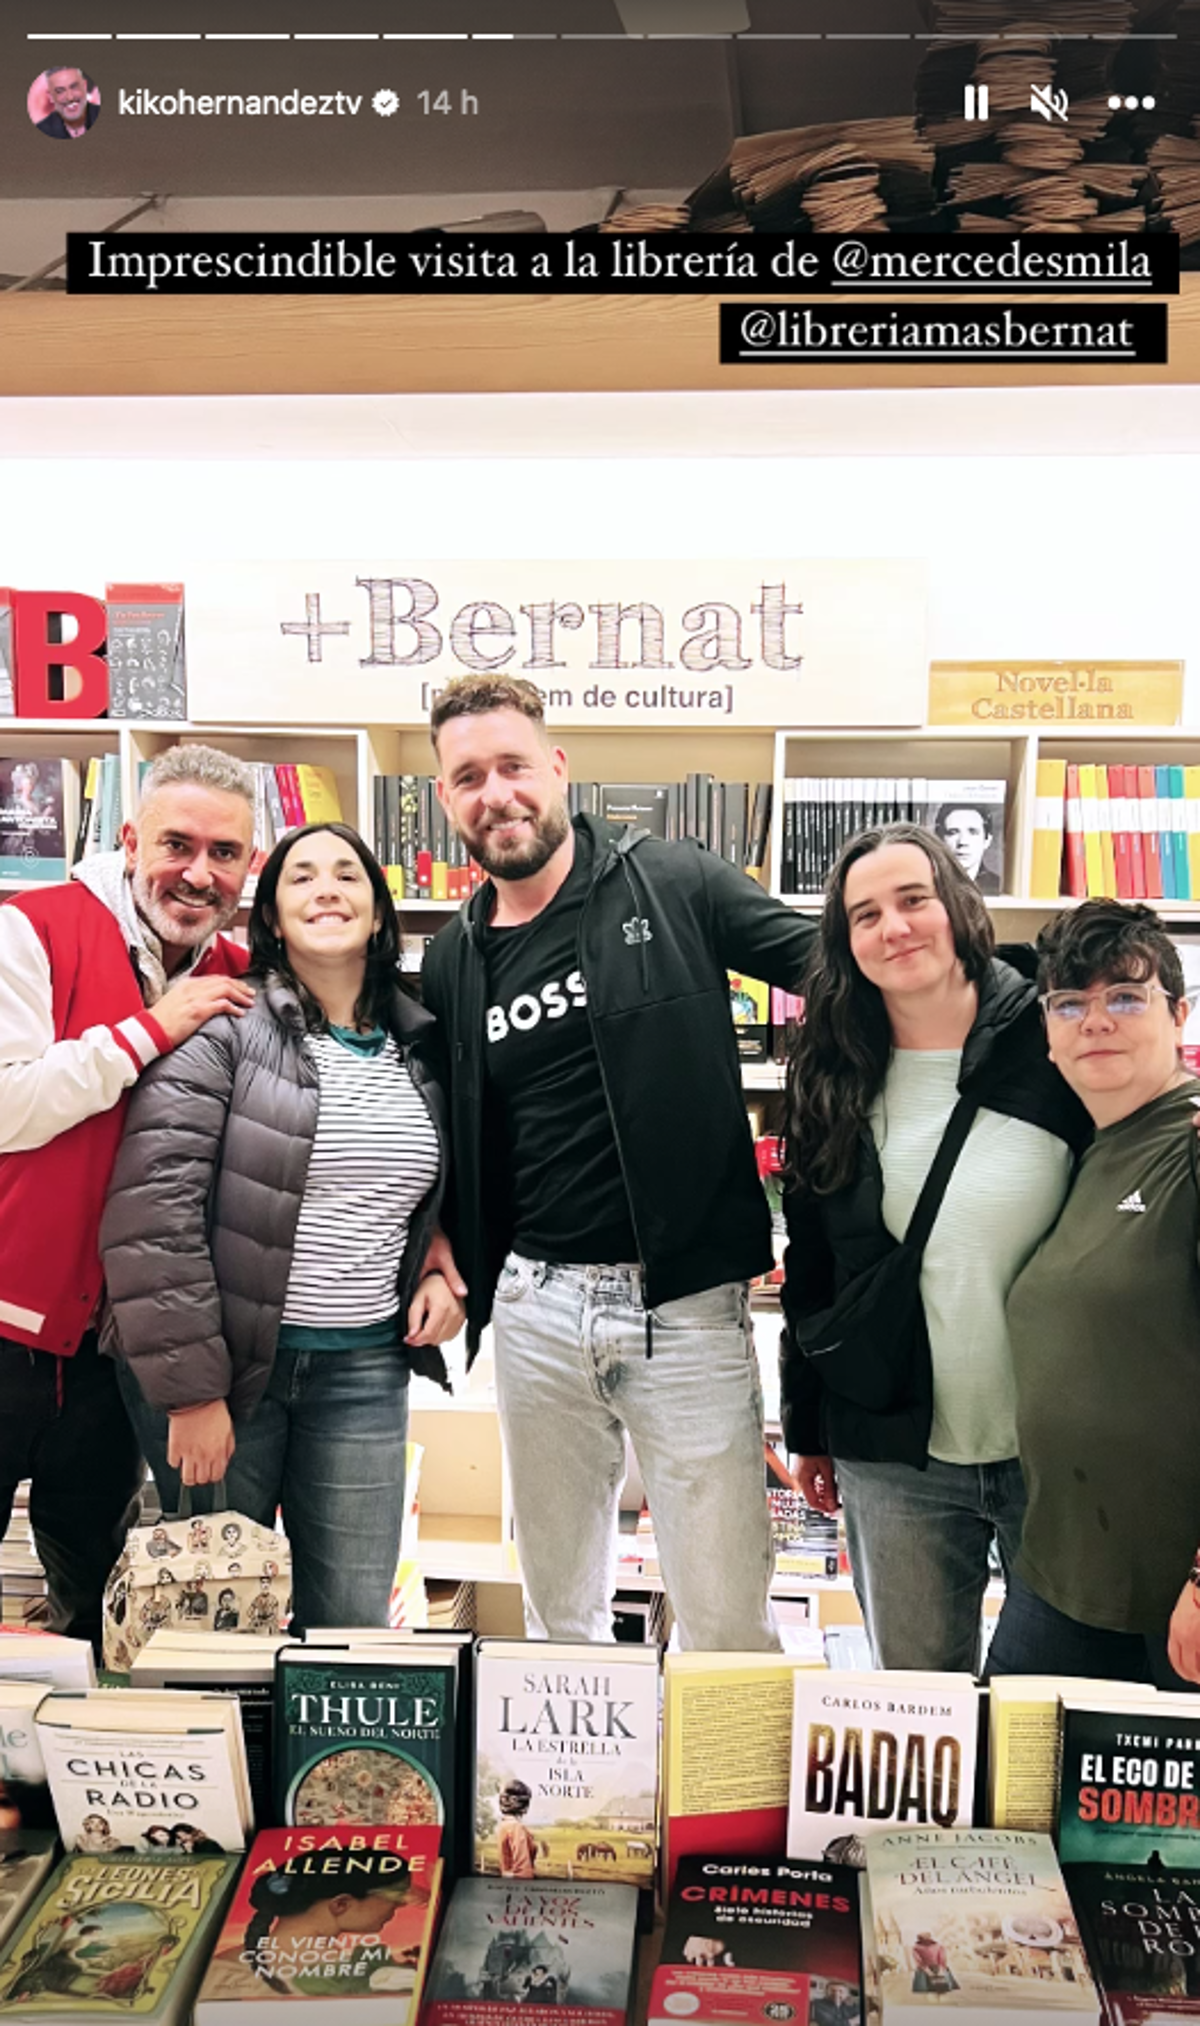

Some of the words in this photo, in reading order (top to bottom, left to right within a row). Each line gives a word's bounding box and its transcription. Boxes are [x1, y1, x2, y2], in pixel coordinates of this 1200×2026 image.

[280, 575, 804, 670] +Bernat
[14, 590, 109, 718] B
[583, 685, 616, 708] de
[625, 685, 733, 713] cultura]
[971, 697, 1134, 720] Castellana
[486, 970, 587, 1043] BOSS
[523, 1673, 611, 1696] SARAH
[291, 1693, 439, 1728] THULE
[822, 1695, 881, 1711] CARLOS
[887, 1702, 953, 1717] BARDEM
[498, 1696, 637, 1739] LARK
[289, 1725, 306, 1735] EL
[360, 1727, 388, 1739] DEL
[391, 1728, 441, 1740] NORTE
[1115, 1733, 1159, 1748] TXEMI
[512, 1738, 533, 1751] LA
[537, 1739, 622, 1756] ESTRELLA
[67, 1758, 206, 1781] CHICAS
[549, 1768, 584, 1782] ISLA
[804, 1722, 962, 1829] BADAQ
[1081, 1753, 1107, 1783] EL
[1112, 1755, 1159, 1787] ECO
[1163, 1760, 1194, 1790] DE
[86, 1788, 199, 1810] RADIO
[538, 1784, 595, 1799] NORTE
[284, 1834, 409, 1851] ISABEL
[882, 1834, 944, 1847] ANNE
[953, 1833, 1038, 1846] JACOBS
[98, 1865, 192, 1882] LEONES
[252, 1855, 427, 1875] ALLENDE
[703, 1864, 770, 1876] Carles
[895, 1872, 950, 1886] DEL
[57, 1875, 202, 1910] SICILIA
[681, 1886, 851, 1912] CRÍMENES
[1153, 1888, 1197, 1907] LA
[1138, 1920, 1183, 1938] DE
[256, 1936, 283, 1950] EL
[290, 1934, 382, 1949] VIENTO
[238, 1949, 352, 1964] CONOCE
[359, 1947, 392, 1961] MI
[254, 1962, 368, 1979] NOMBRE
